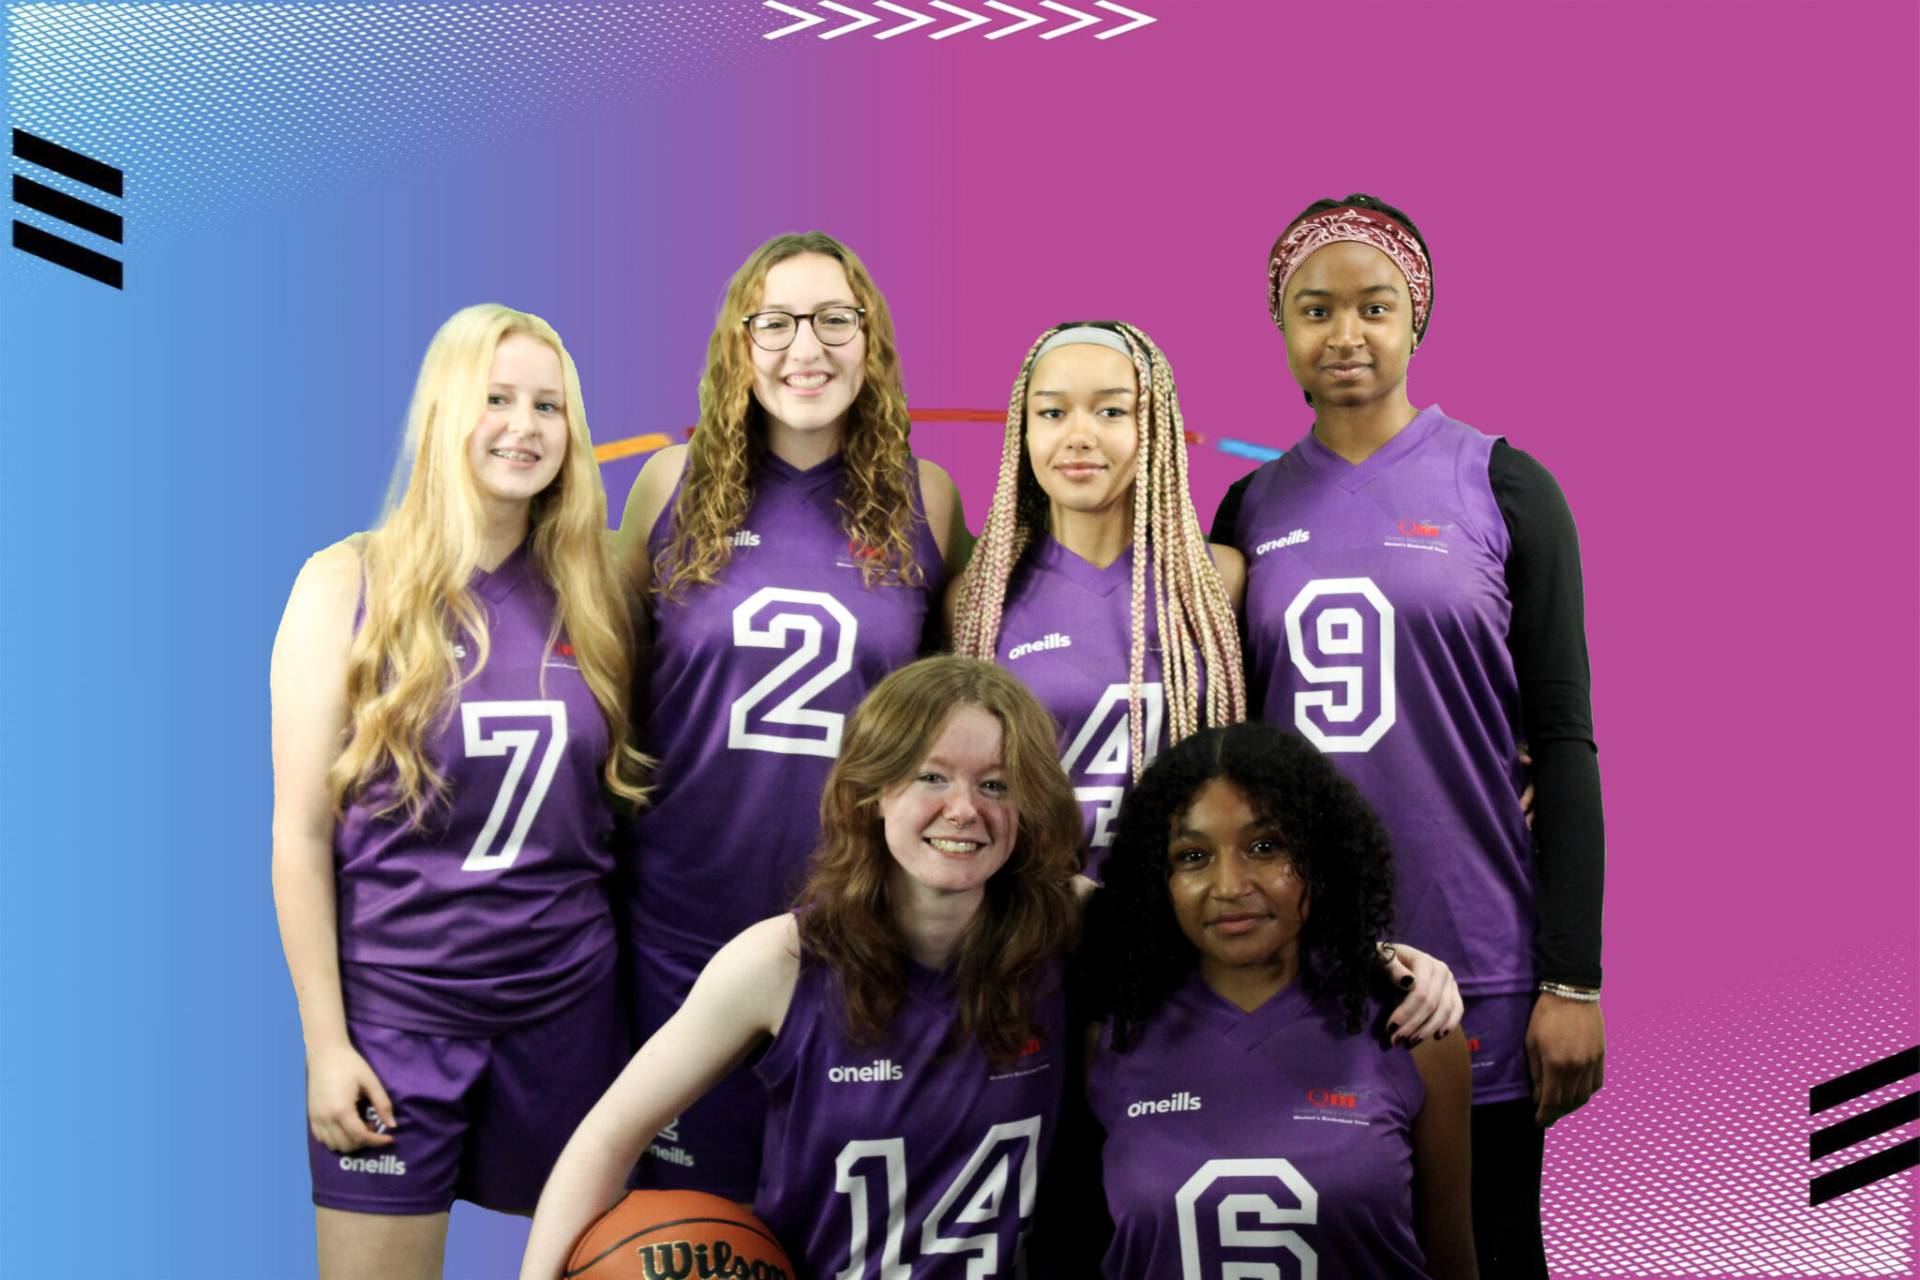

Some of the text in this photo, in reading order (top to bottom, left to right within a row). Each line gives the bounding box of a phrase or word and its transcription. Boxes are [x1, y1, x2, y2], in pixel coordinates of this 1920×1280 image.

[728, 586, 858, 758] 2
[1284, 577, 1396, 753] 9
[461, 700, 568, 871] 7
[1059, 682, 1163, 847] 4
[651, 1145, 694, 1167] neills
[835, 1114, 1041, 1280] 14
[1175, 1158, 1318, 1280] 6
[637, 1240, 788, 1280] Wilson
